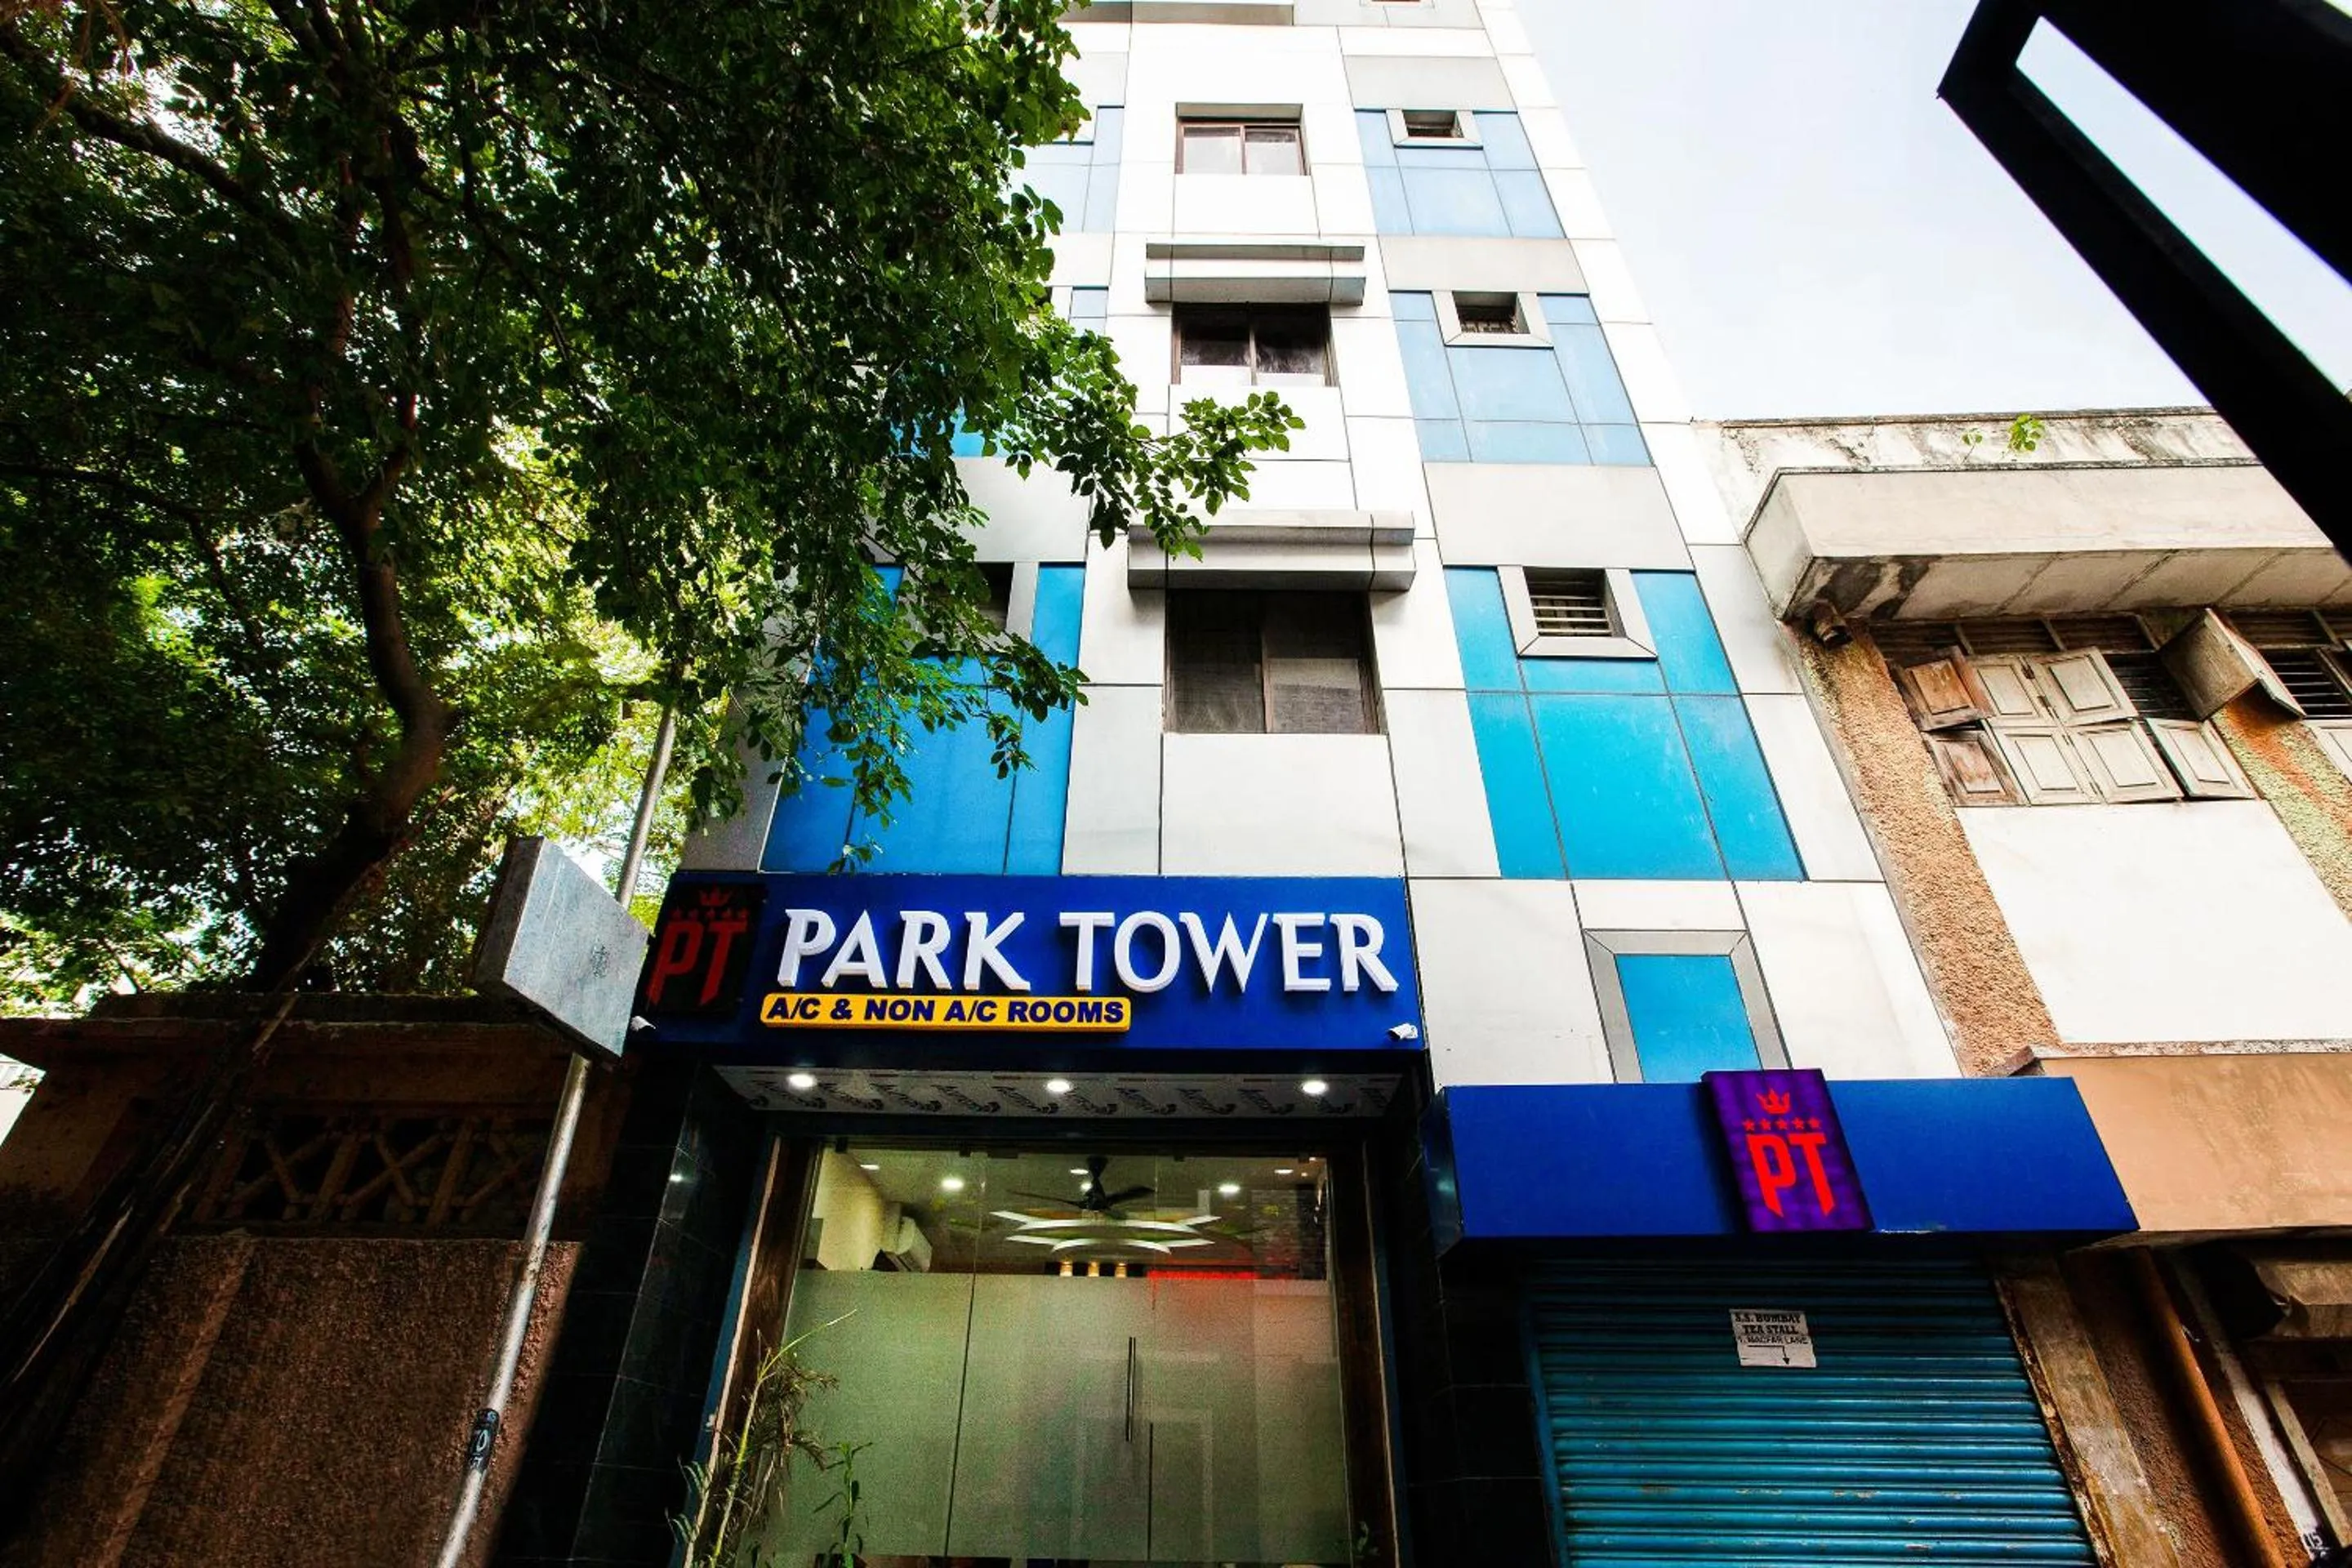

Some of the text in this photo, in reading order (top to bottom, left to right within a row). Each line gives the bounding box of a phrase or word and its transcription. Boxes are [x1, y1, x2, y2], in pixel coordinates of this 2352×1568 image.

[646, 917, 747, 1007] PT
[777, 908, 1400, 994] PARK TOWER
[767, 997, 1125, 1023] A/C & NON A/C ROOMS
[1745, 1132, 1836, 1218] PT
[1742, 1325, 1798, 1334] TEA STALL
[1755, 1313, 1801, 1323] BOMBAY
